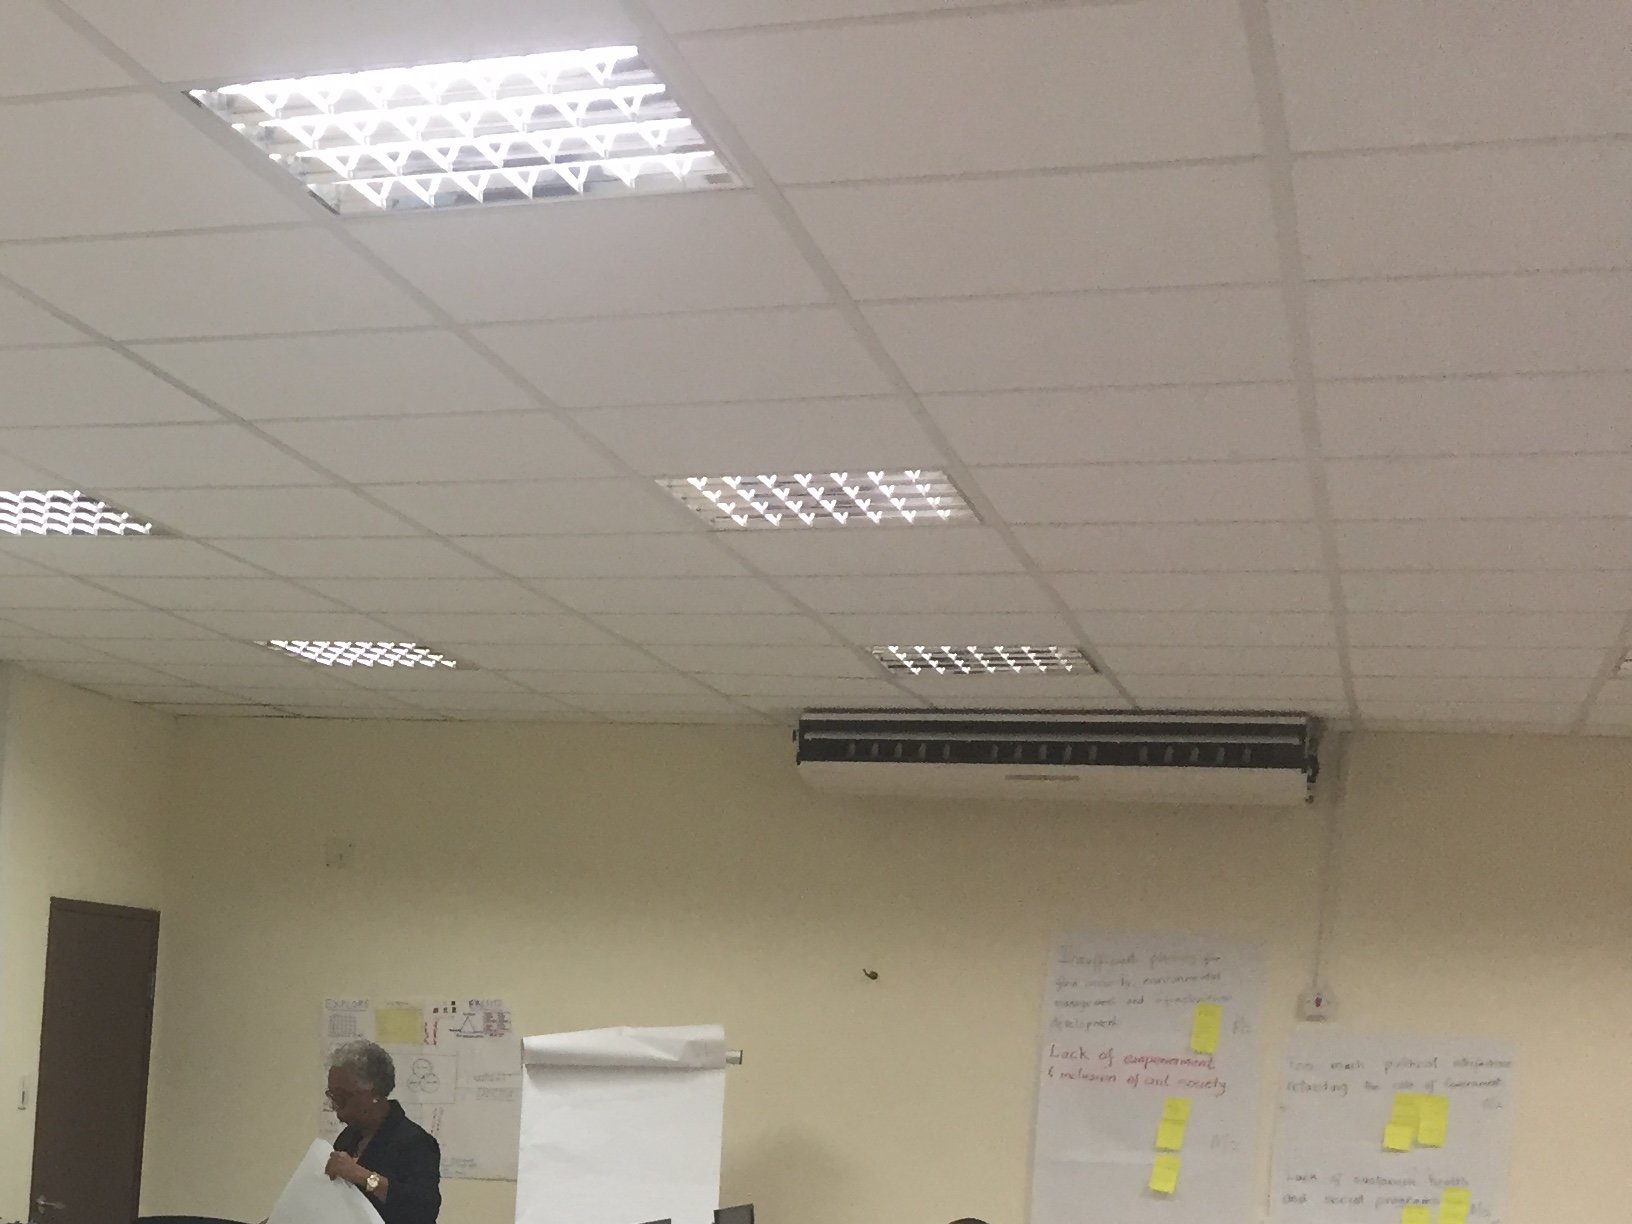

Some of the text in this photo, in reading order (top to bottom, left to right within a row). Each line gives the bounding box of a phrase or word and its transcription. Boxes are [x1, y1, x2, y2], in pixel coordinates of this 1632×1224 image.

[1049, 1043, 1090, 1060] Lack
[1098, 1047, 1114, 1067] of
[1060, 1067, 1118, 1083] inclusion
[1126, 1071, 1141, 1089] of
[1177, 1074, 1227, 1099] society
